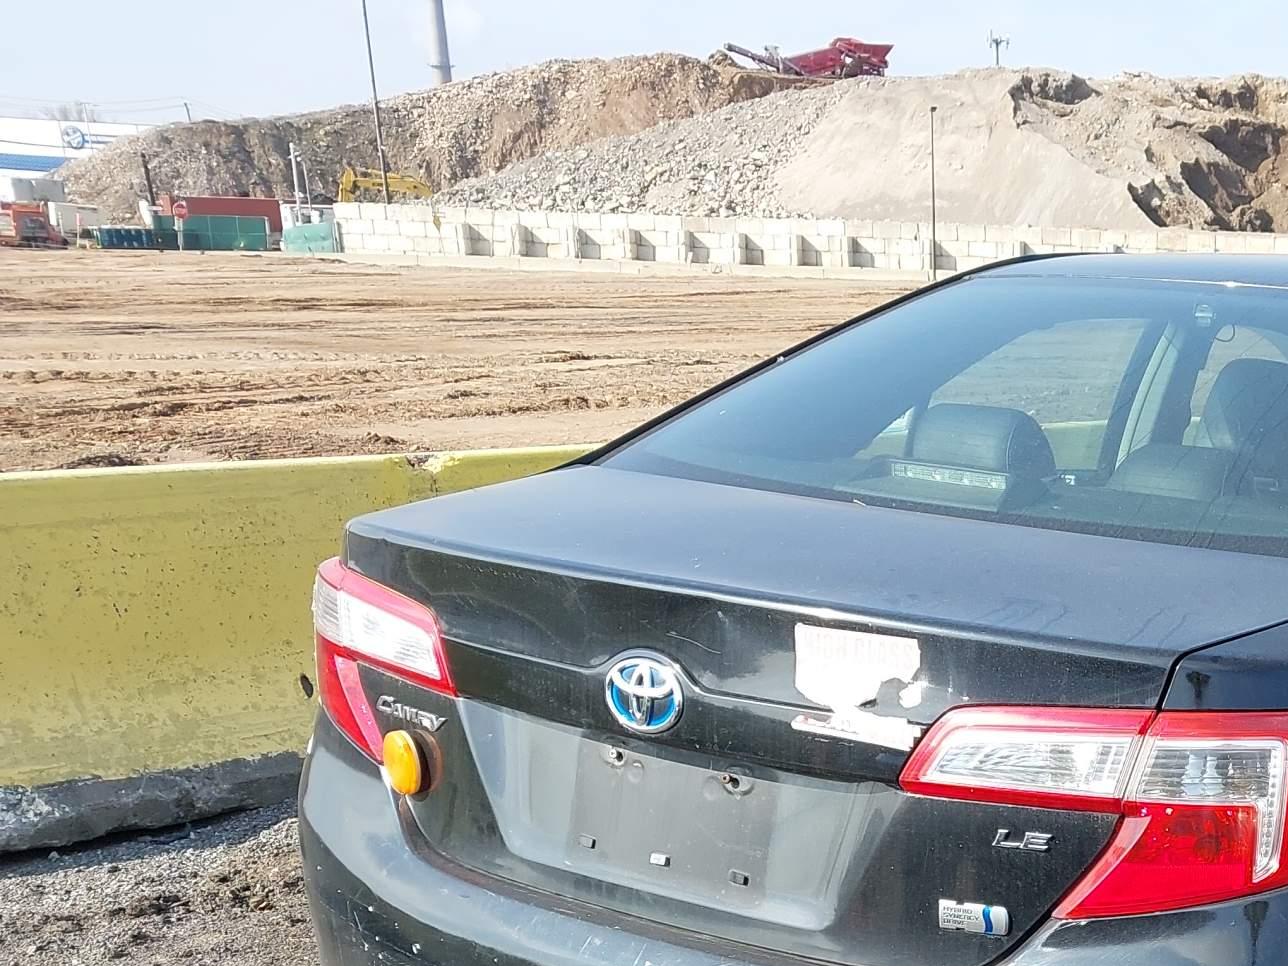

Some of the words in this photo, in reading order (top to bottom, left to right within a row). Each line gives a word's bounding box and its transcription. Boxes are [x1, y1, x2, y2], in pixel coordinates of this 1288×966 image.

[991, 828, 1054, 852] LE
[943, 905, 973, 915] HYBRID
[943, 911, 980, 922] SYNERGY
[943, 917, 968, 926] DRIVE
